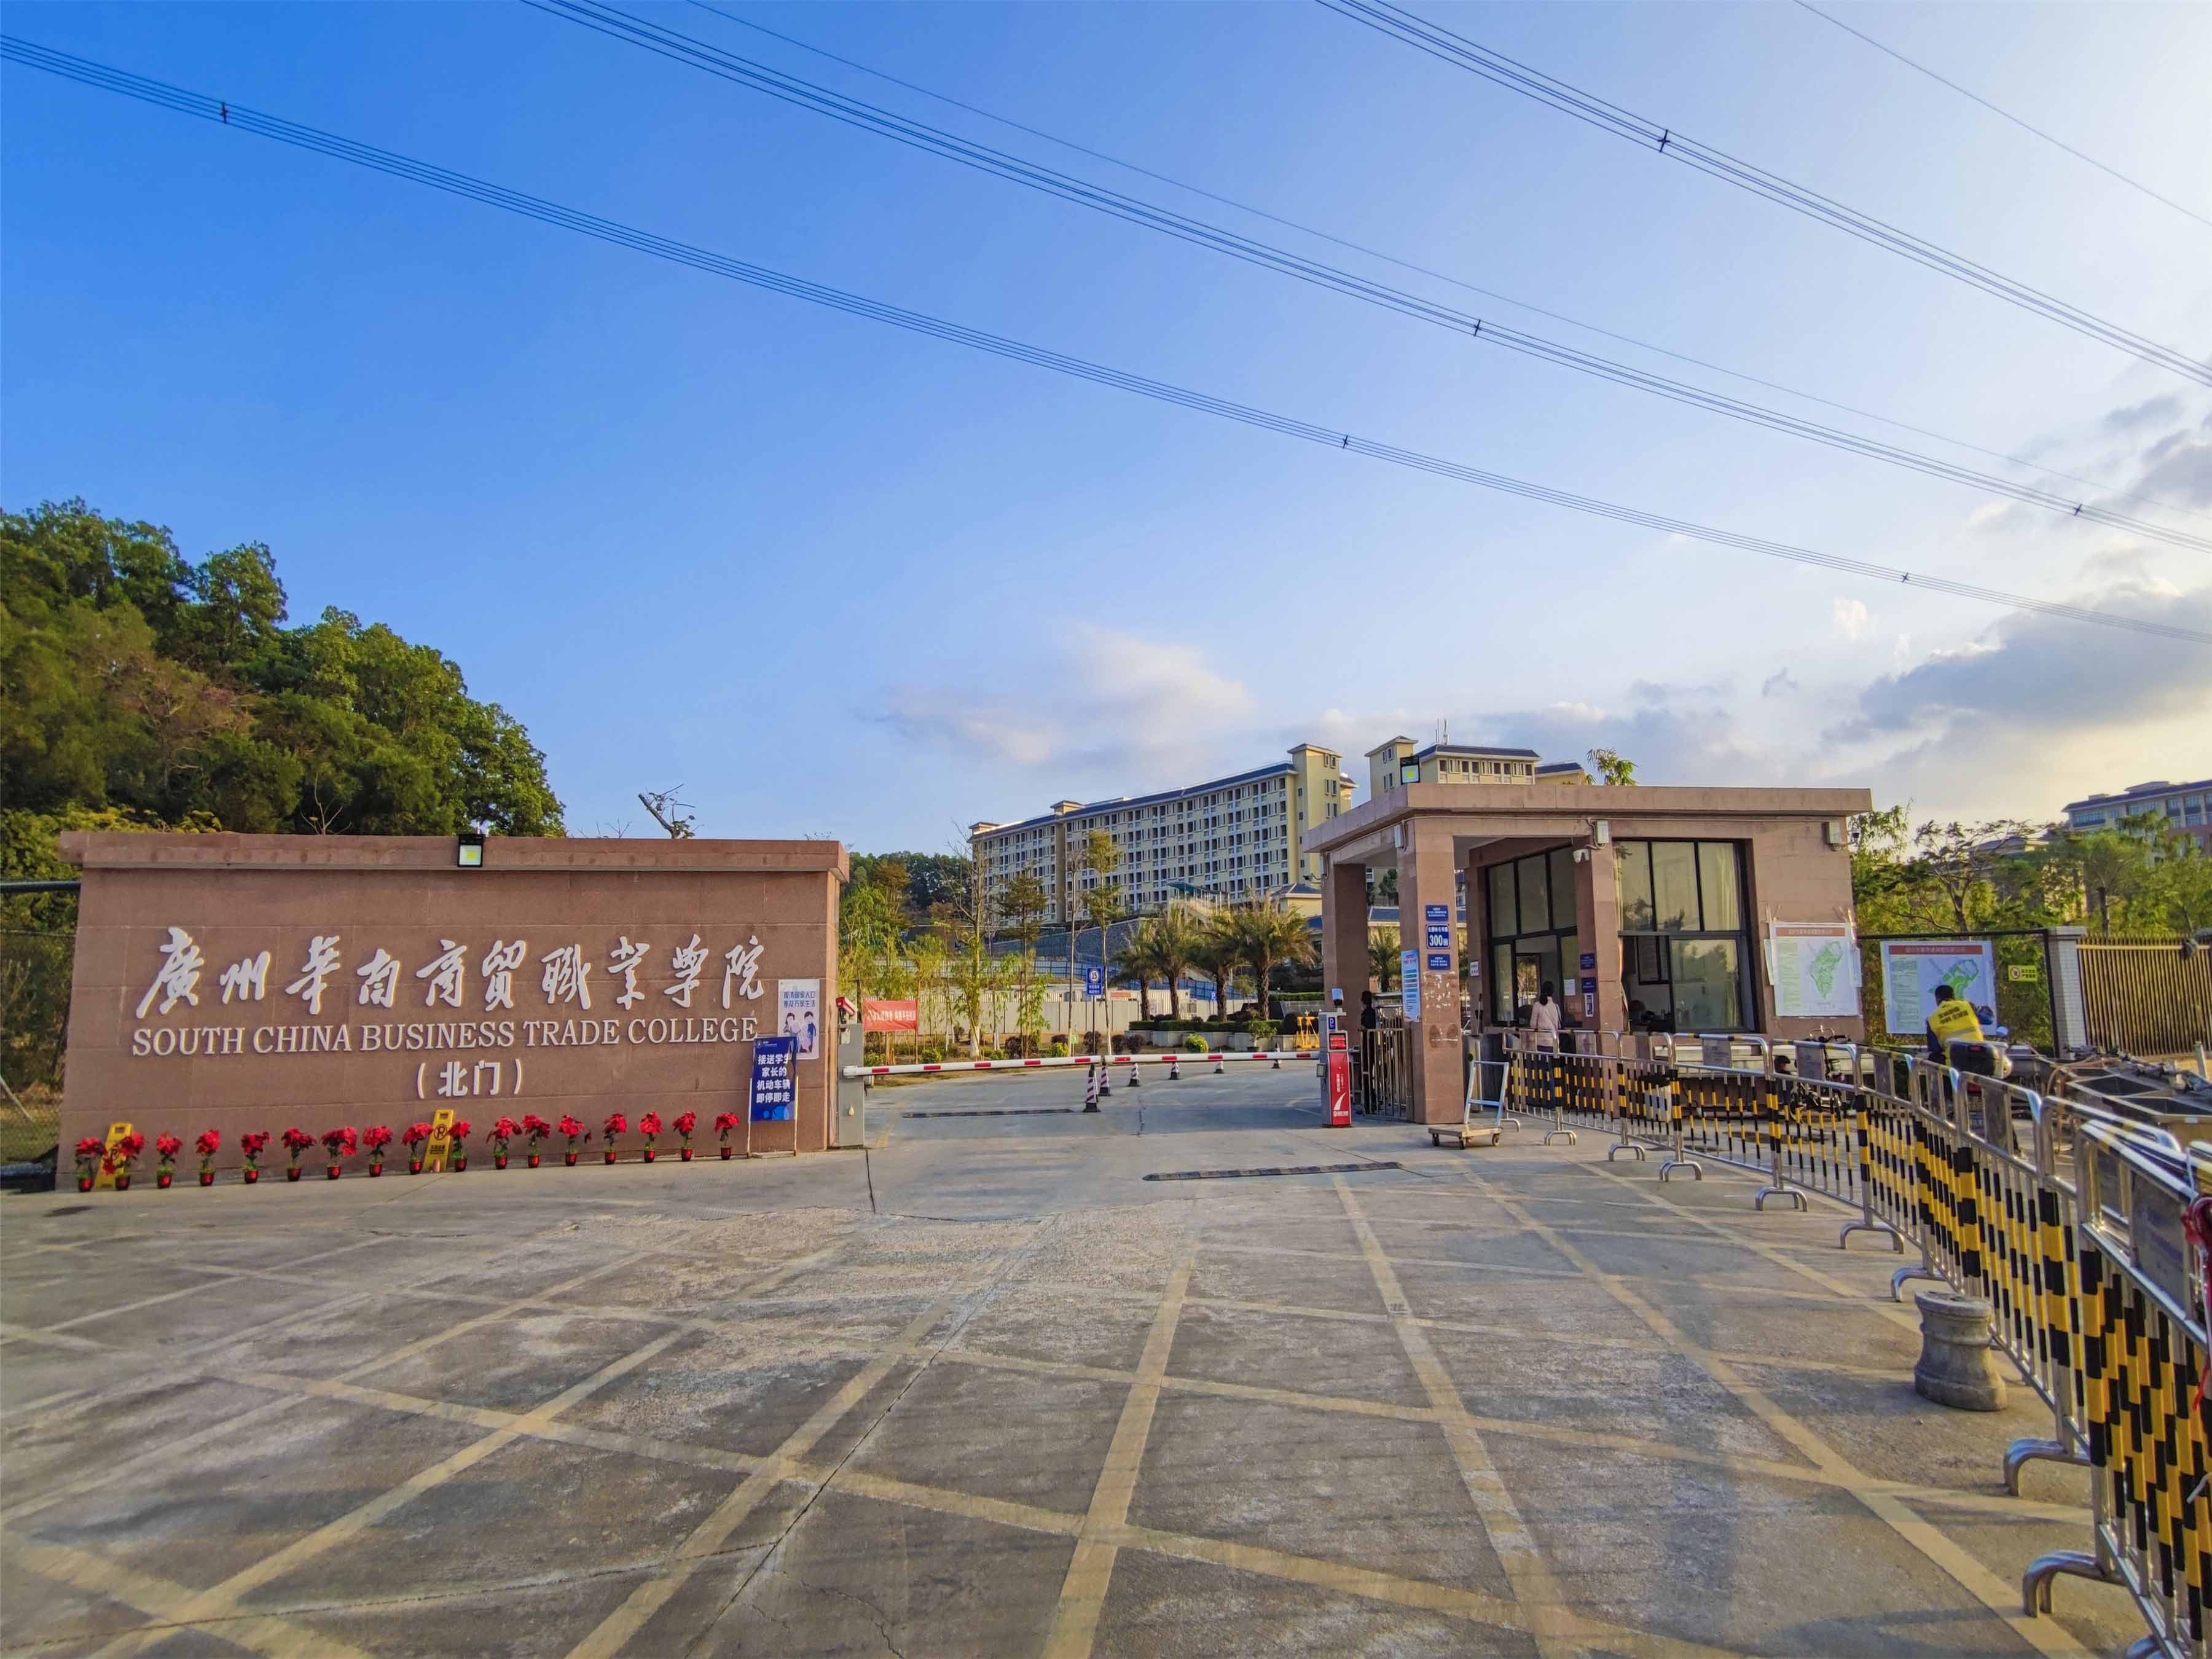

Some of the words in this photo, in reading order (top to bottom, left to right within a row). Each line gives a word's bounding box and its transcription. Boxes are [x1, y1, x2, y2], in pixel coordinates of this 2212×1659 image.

[132, 1027, 246, 1056] SOUTH
[253, 1024, 352, 1054] CHINA
[359, 1021, 515, 1052] BUSINESS
[523, 1019, 620, 1046] TRADE
[628, 1017, 758, 1044] COLLEGE
[758, 1053, 789, 1065] 接送学生
[761, 1066, 787, 1078] 家长的
[756, 1079, 791, 1091] 机动车辆
[756, 1092, 791, 1104] 即停即走
